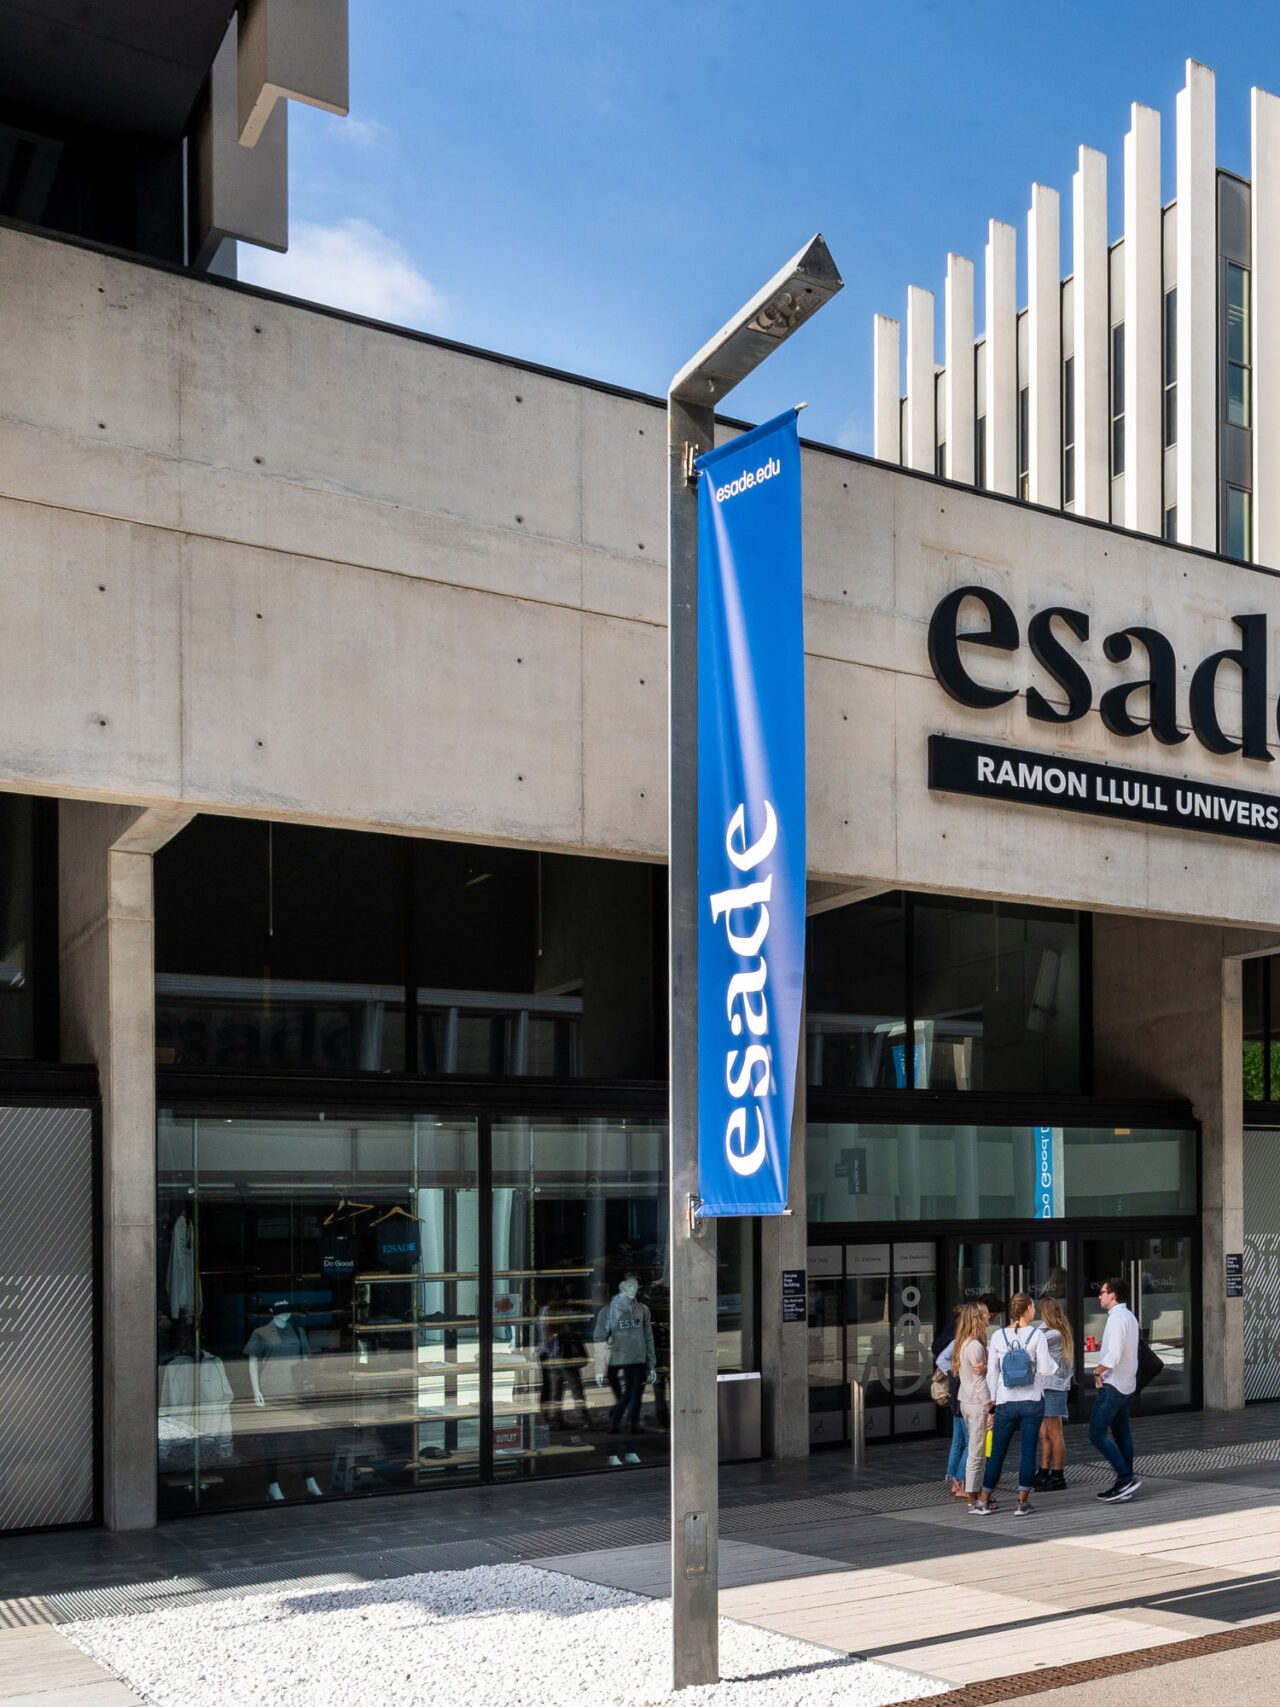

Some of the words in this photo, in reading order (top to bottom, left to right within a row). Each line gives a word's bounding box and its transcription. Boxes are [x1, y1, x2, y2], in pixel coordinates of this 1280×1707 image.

[716, 457, 781, 503] esade.edu
[977, 755, 1087, 798] RAMON
[1095, 776, 1168, 812] LLULL
[709, 800, 778, 1176] esade
